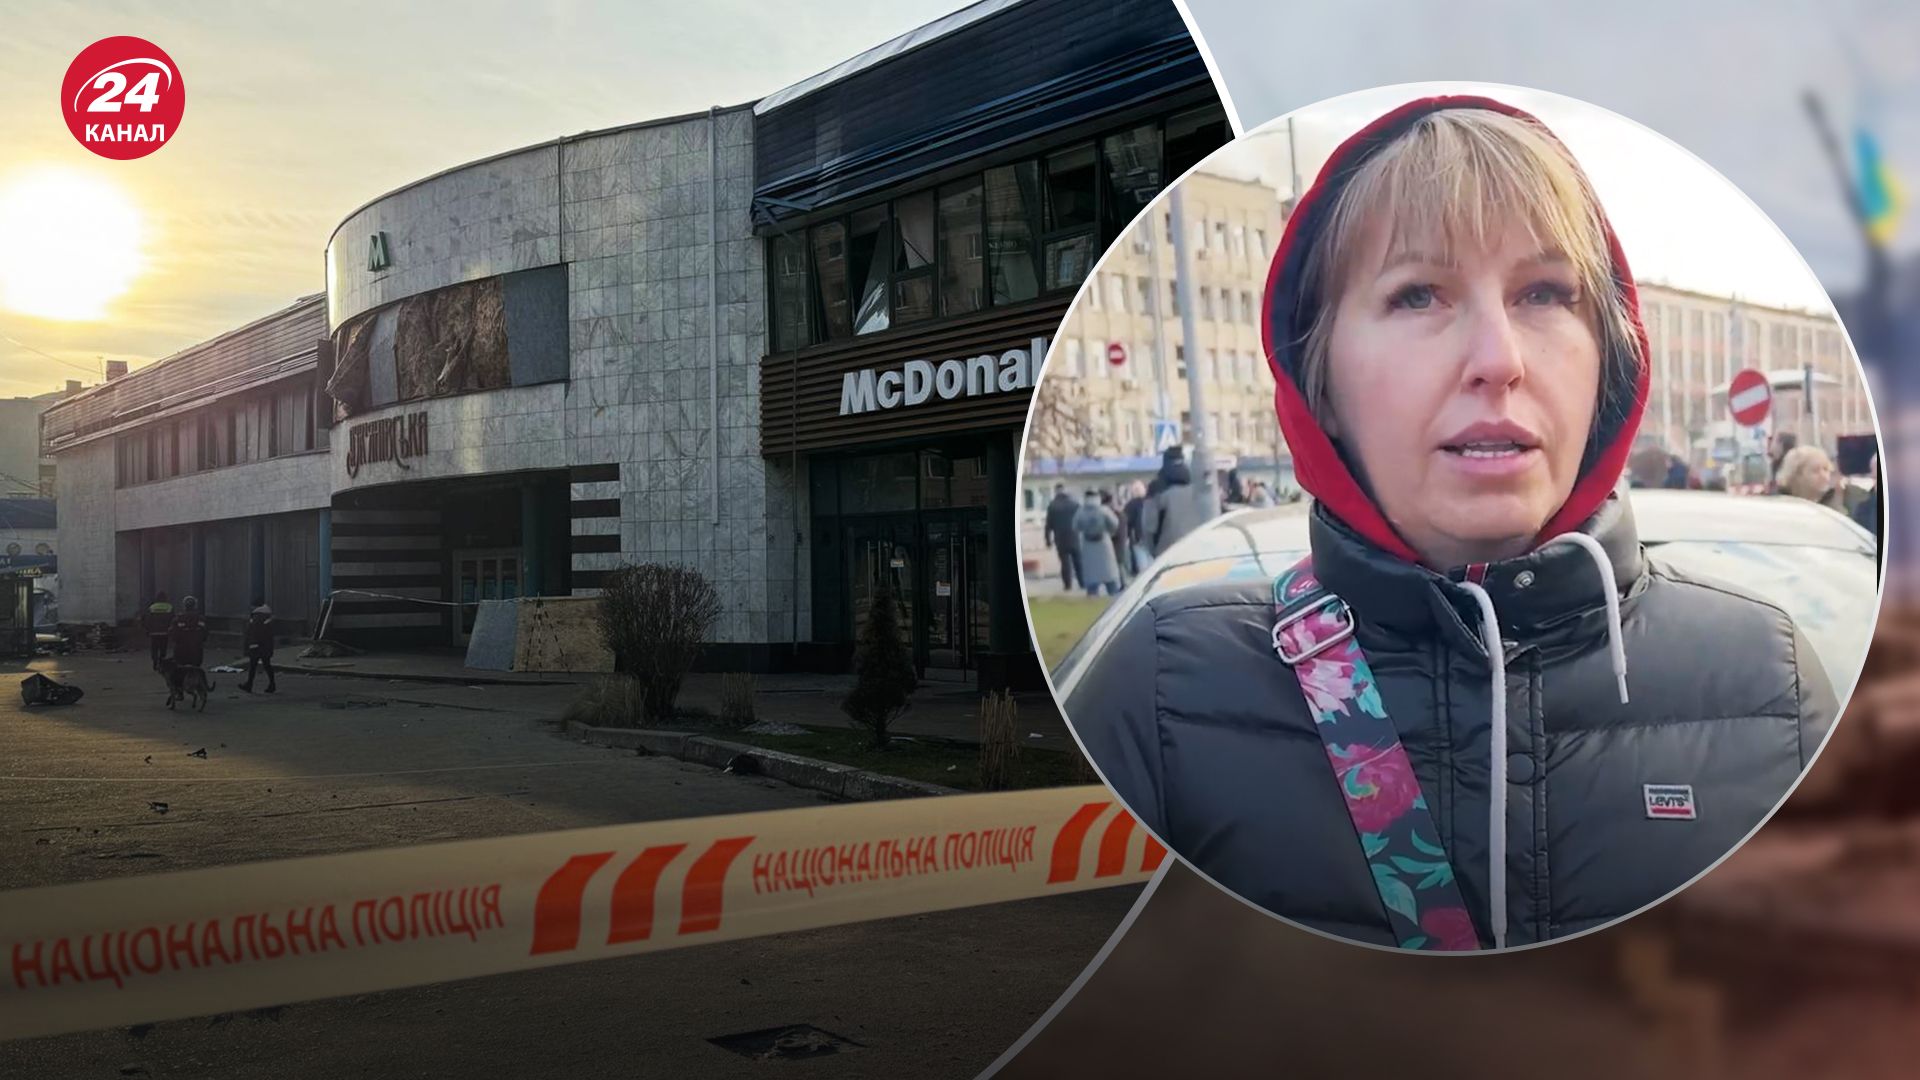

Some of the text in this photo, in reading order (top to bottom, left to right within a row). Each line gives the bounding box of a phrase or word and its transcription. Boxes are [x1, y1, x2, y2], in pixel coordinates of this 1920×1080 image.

[839, 336, 1048, 416] McDonal
[752, 825, 1037, 898] НАЦІОНАЛЬНА ПОЛІЦІЯ
[11, 883, 505, 989] НАЦІОНАЛЬНА ПОЛІЦІЯ
